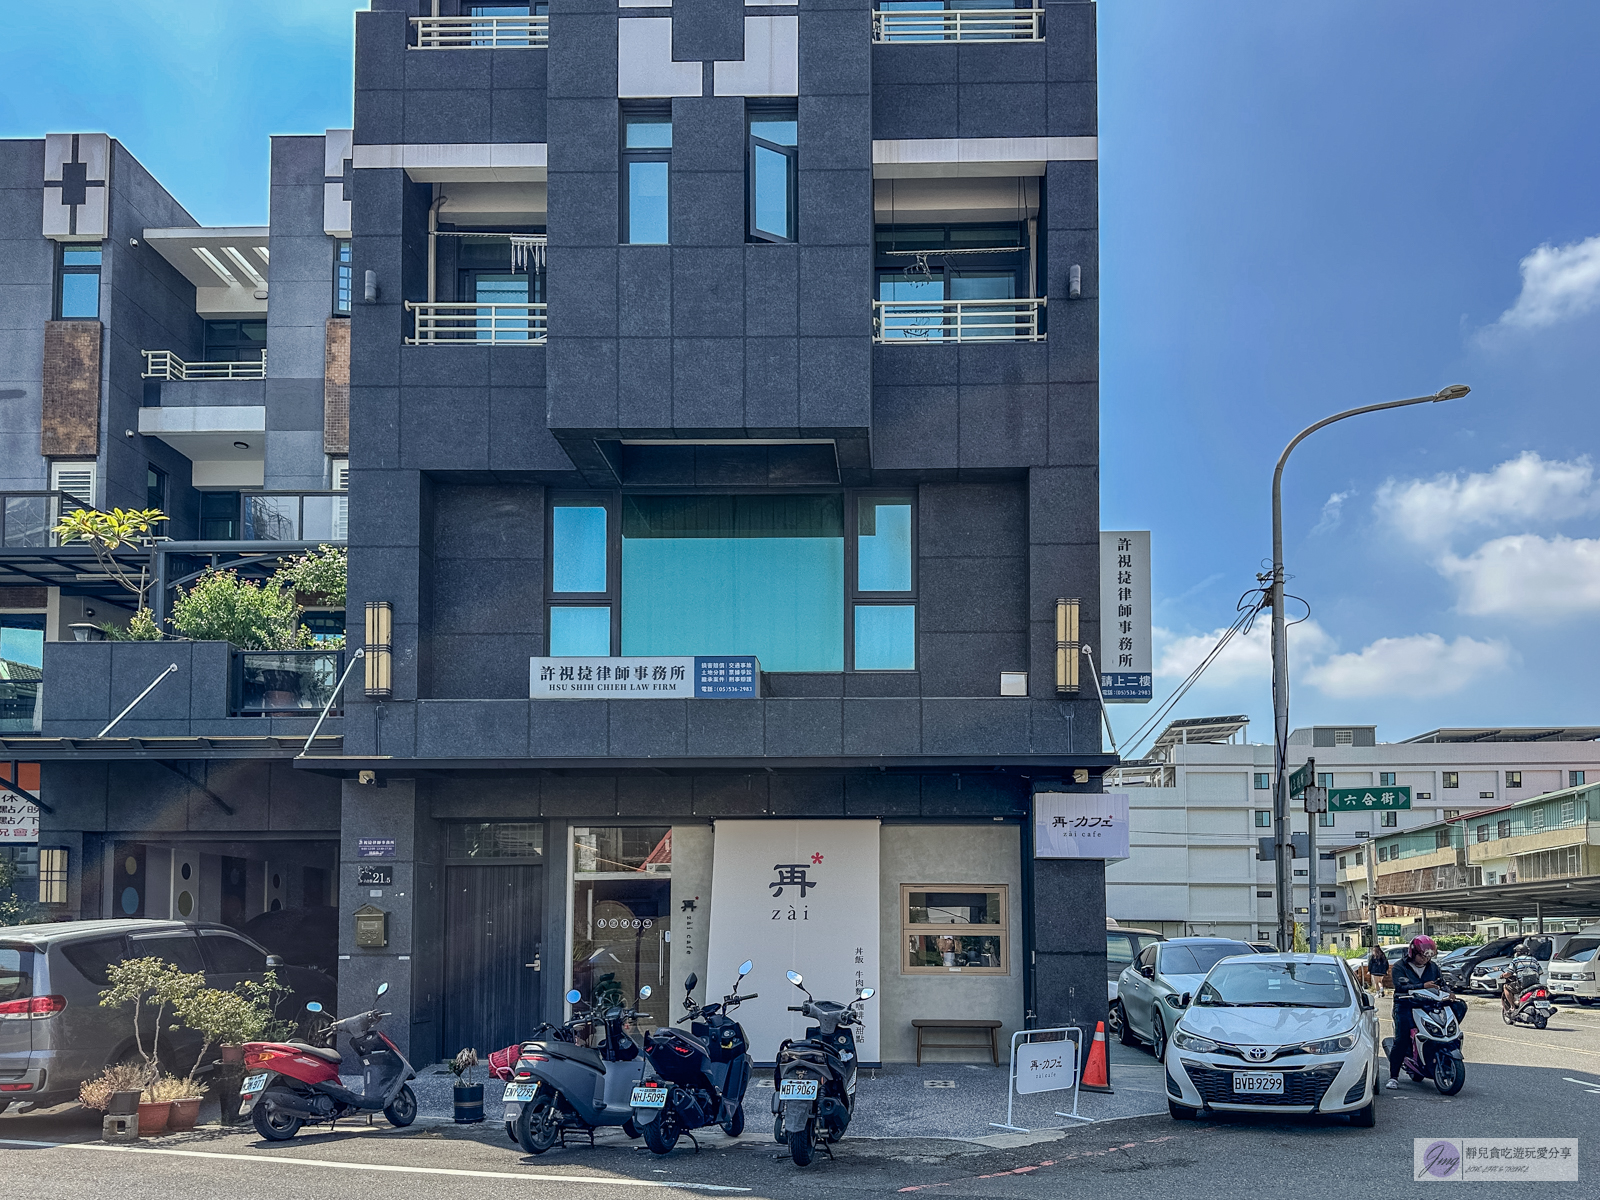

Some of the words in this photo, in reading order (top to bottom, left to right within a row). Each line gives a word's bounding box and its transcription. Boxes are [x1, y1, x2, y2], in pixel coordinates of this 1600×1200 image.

[1117, 537, 1133, 668] 許視捷律師事務所
[540, 665, 686, 681] 許視捷律師事務所
[549, 683, 568, 691] HSU
[570, 683, 594, 691] SHIH
[597, 683, 627, 691] CHIEH
[630, 683, 650, 691] LAW
[653, 683, 677, 691] FIRM
[1101, 675, 1151, 687] 請上二樓
[1344, 792, 1395, 806] 六合街
[769, 864, 817, 898] 再
[771, 904, 809, 920] zài
[686, 934, 694, 954] cafe
[855, 947, 864, 964] 丼飯
[781, 1084, 816, 1095] MBT-9069
[1234, 1077, 1282, 1090] BVB-9299
[633, 1092, 665, 1103] NHJ-5095
